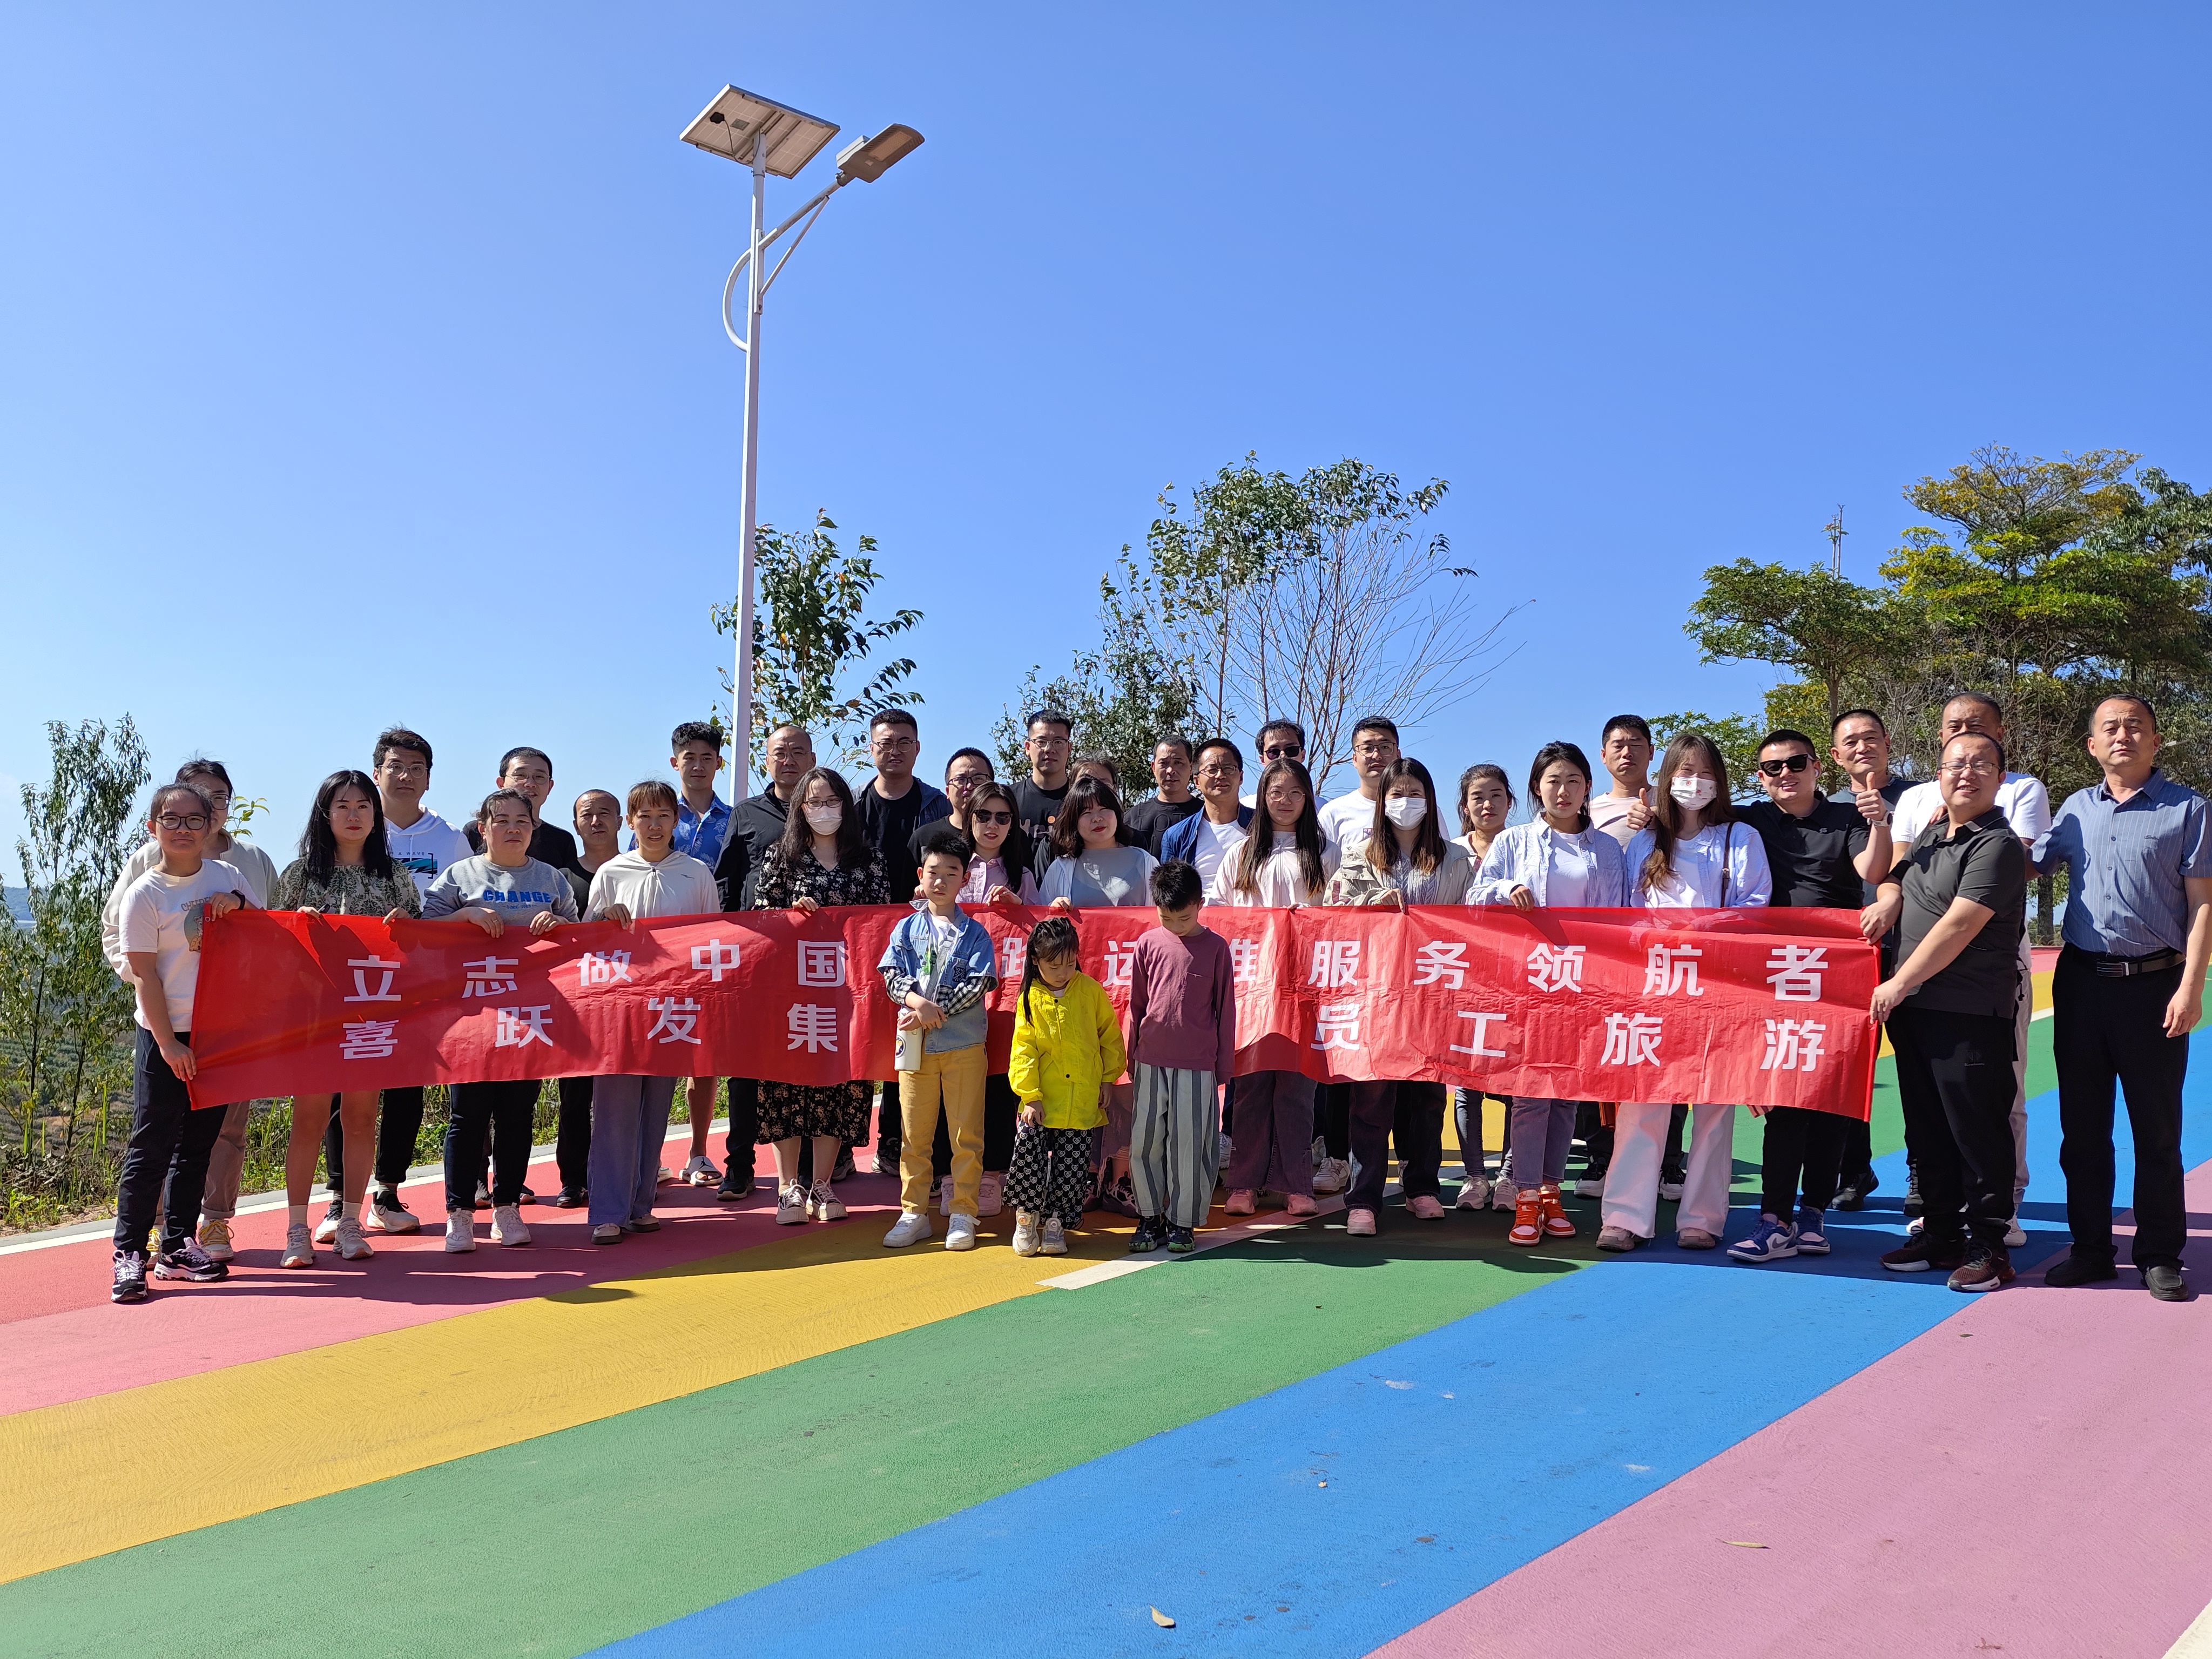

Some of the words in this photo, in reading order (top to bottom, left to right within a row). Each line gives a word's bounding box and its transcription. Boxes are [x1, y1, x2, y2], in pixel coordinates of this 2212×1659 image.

[483, 890, 551, 902] CHANGE
[339, 997, 1826, 1071] 喜跃发集员工旅游
